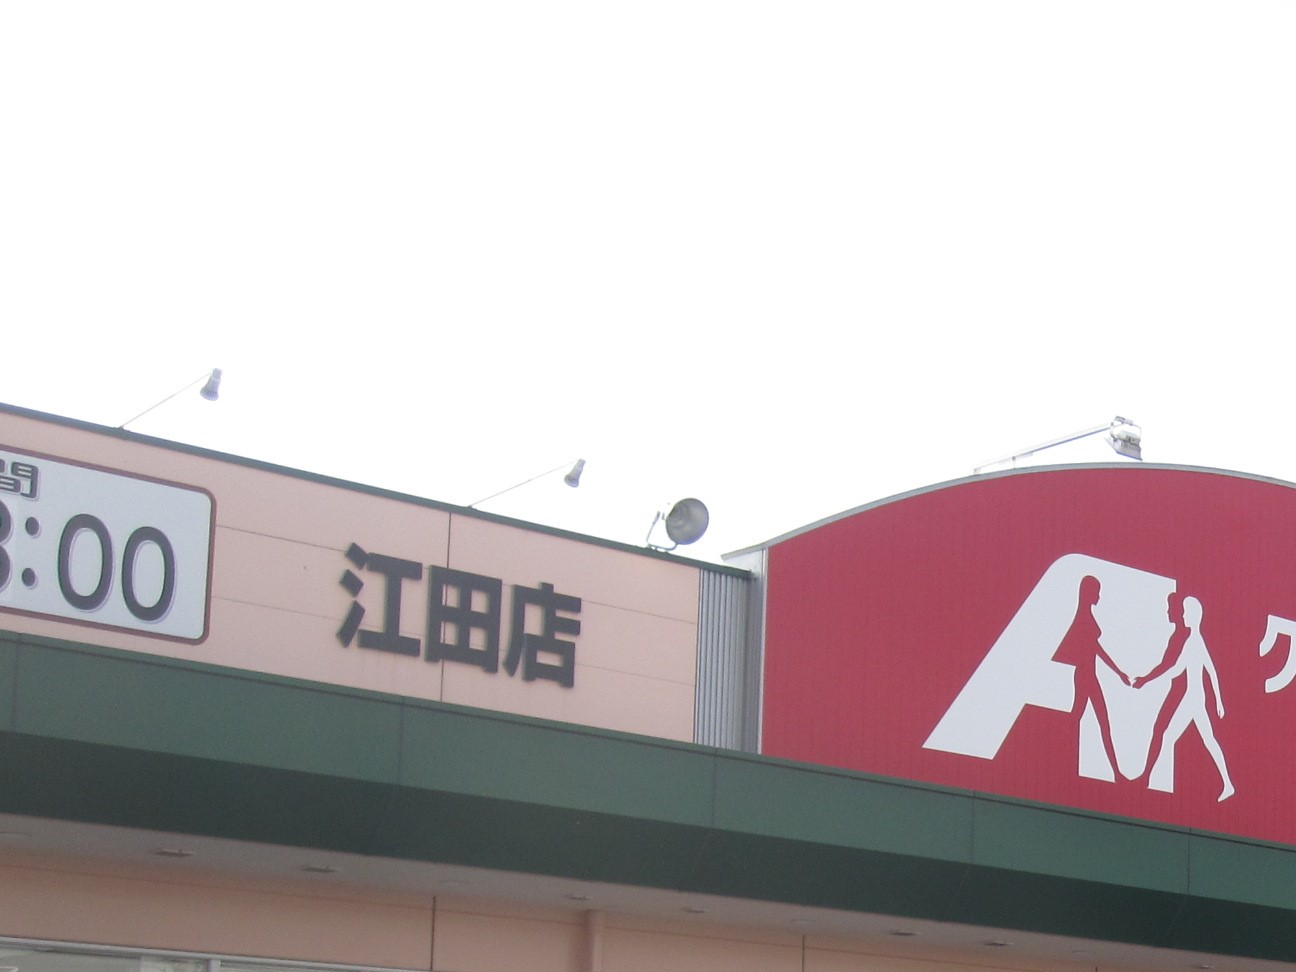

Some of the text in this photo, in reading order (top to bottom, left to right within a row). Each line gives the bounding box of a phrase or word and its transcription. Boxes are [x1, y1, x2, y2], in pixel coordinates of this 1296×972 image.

[0, 500, 176, 622] :00
[335, 541, 583, 689] 江田店
